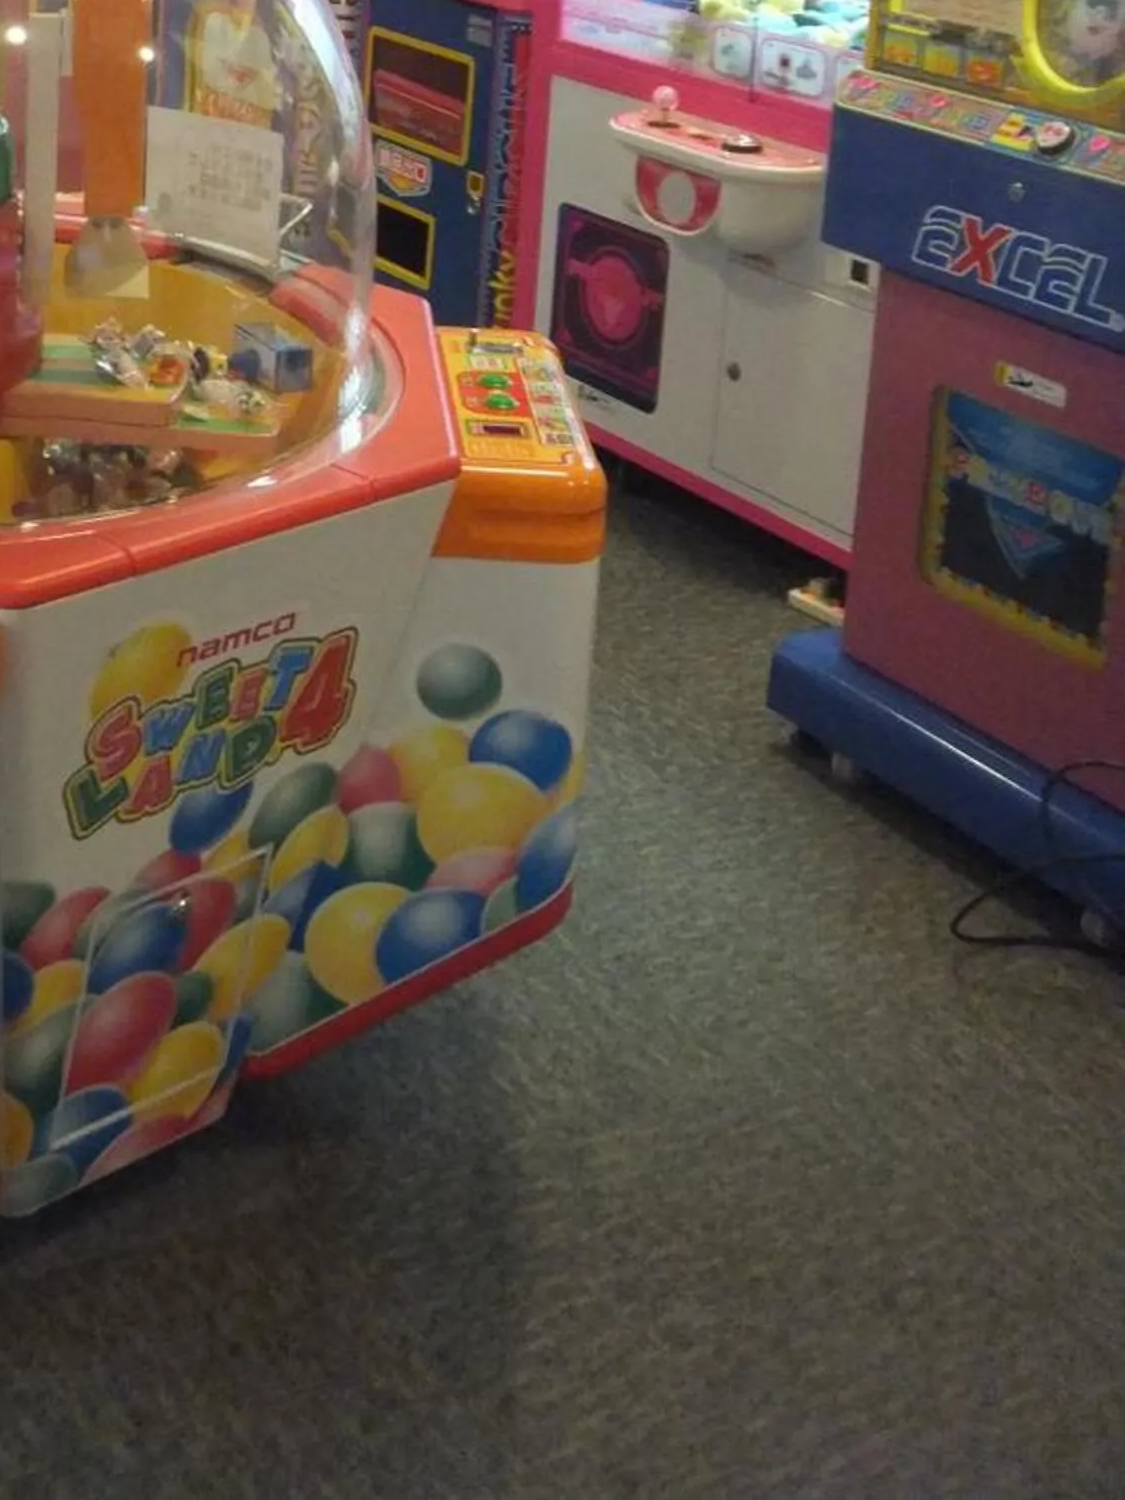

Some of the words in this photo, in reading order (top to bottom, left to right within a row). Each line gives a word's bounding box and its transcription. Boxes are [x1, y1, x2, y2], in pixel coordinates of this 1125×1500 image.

[177, 612, 297, 668] namco
[91, 642, 315, 782] SWEET
[72, 713, 277, 833] LAND
